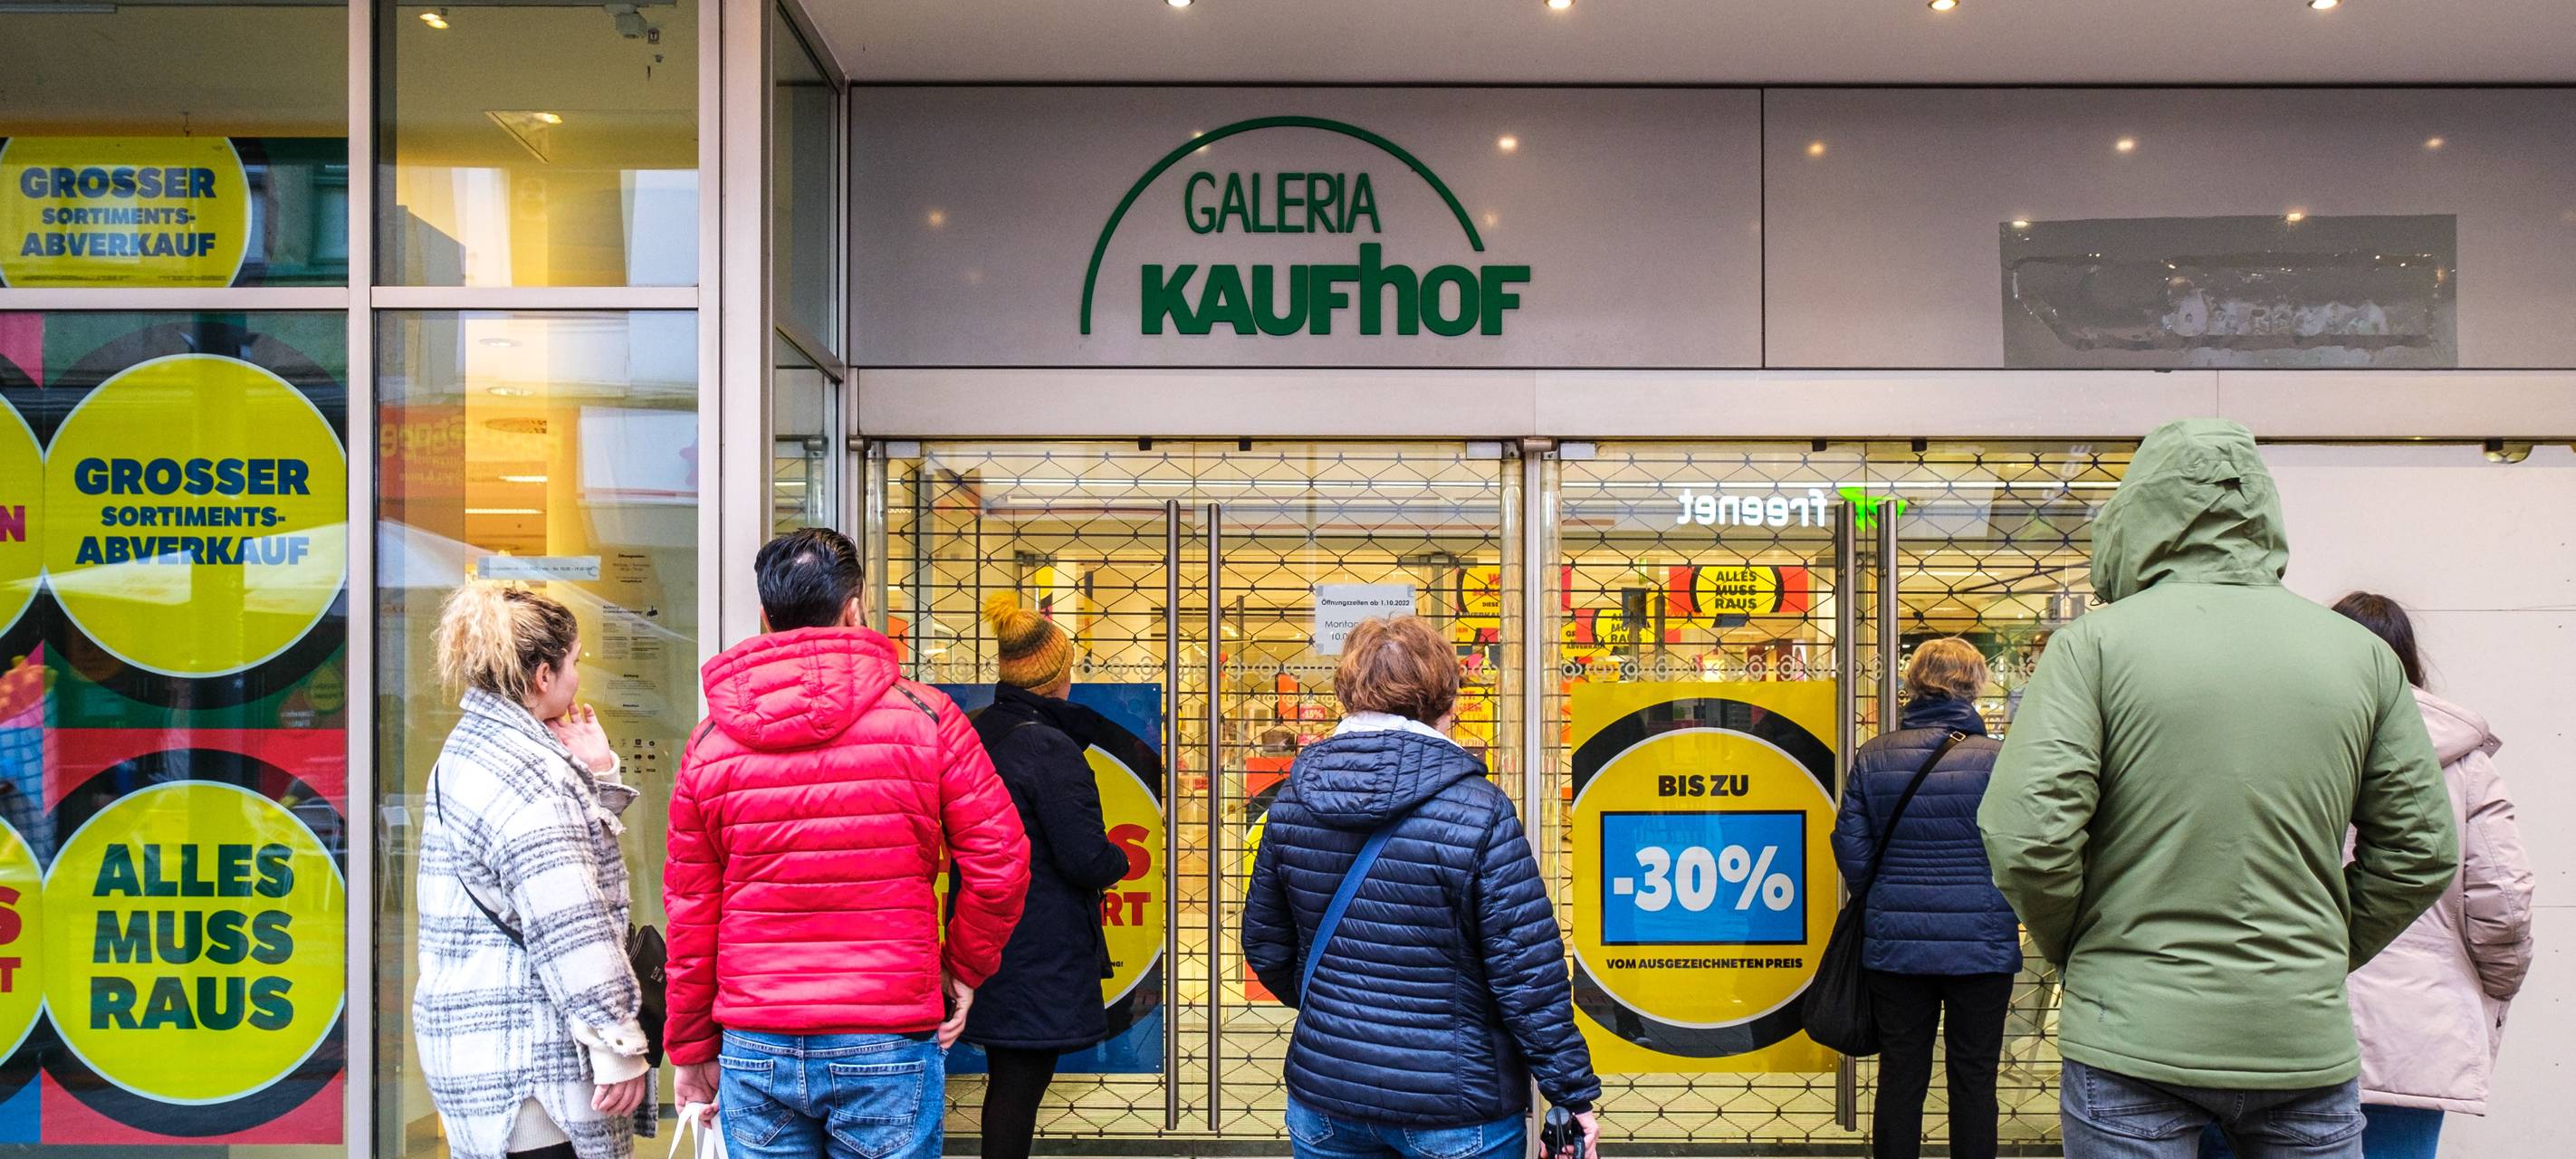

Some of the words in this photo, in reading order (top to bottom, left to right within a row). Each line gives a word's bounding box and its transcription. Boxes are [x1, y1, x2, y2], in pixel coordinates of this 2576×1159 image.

[20, 167, 217, 199] GROSSER
[1184, 171, 1382, 235] GALERIA
[42, 207, 196, 225] SORTIMENTS-
[20, 232, 216, 257] ABVERKAUF
[74, 457, 311, 496] GROSSER
[101, 506, 286, 527] SORTIMENTS-
[75, 535, 310, 565] ABVERKAUF
[1716, 570, 1757, 581] ALLES
[1321, 598, 1369, 607] Öffnungszeiten
[1715, 584, 1757, 596] MUSS
[1715, 598, 1757, 609] RAUS
[1658, 774, 1706, 797] BIS
[1709, 774, 1749, 797] ZU
[92, 842, 294, 898] ALLES
[1613, 844, 1796, 913] -30%
[92, 909, 294, 965] MUSS
[1606, 958, 1637, 970] VOM
[1638, 958, 1765, 970] AUSGEZEICHNETEN
[1766, 958, 1804, 970] PREIS
[90, 975, 294, 1031] RAUS
